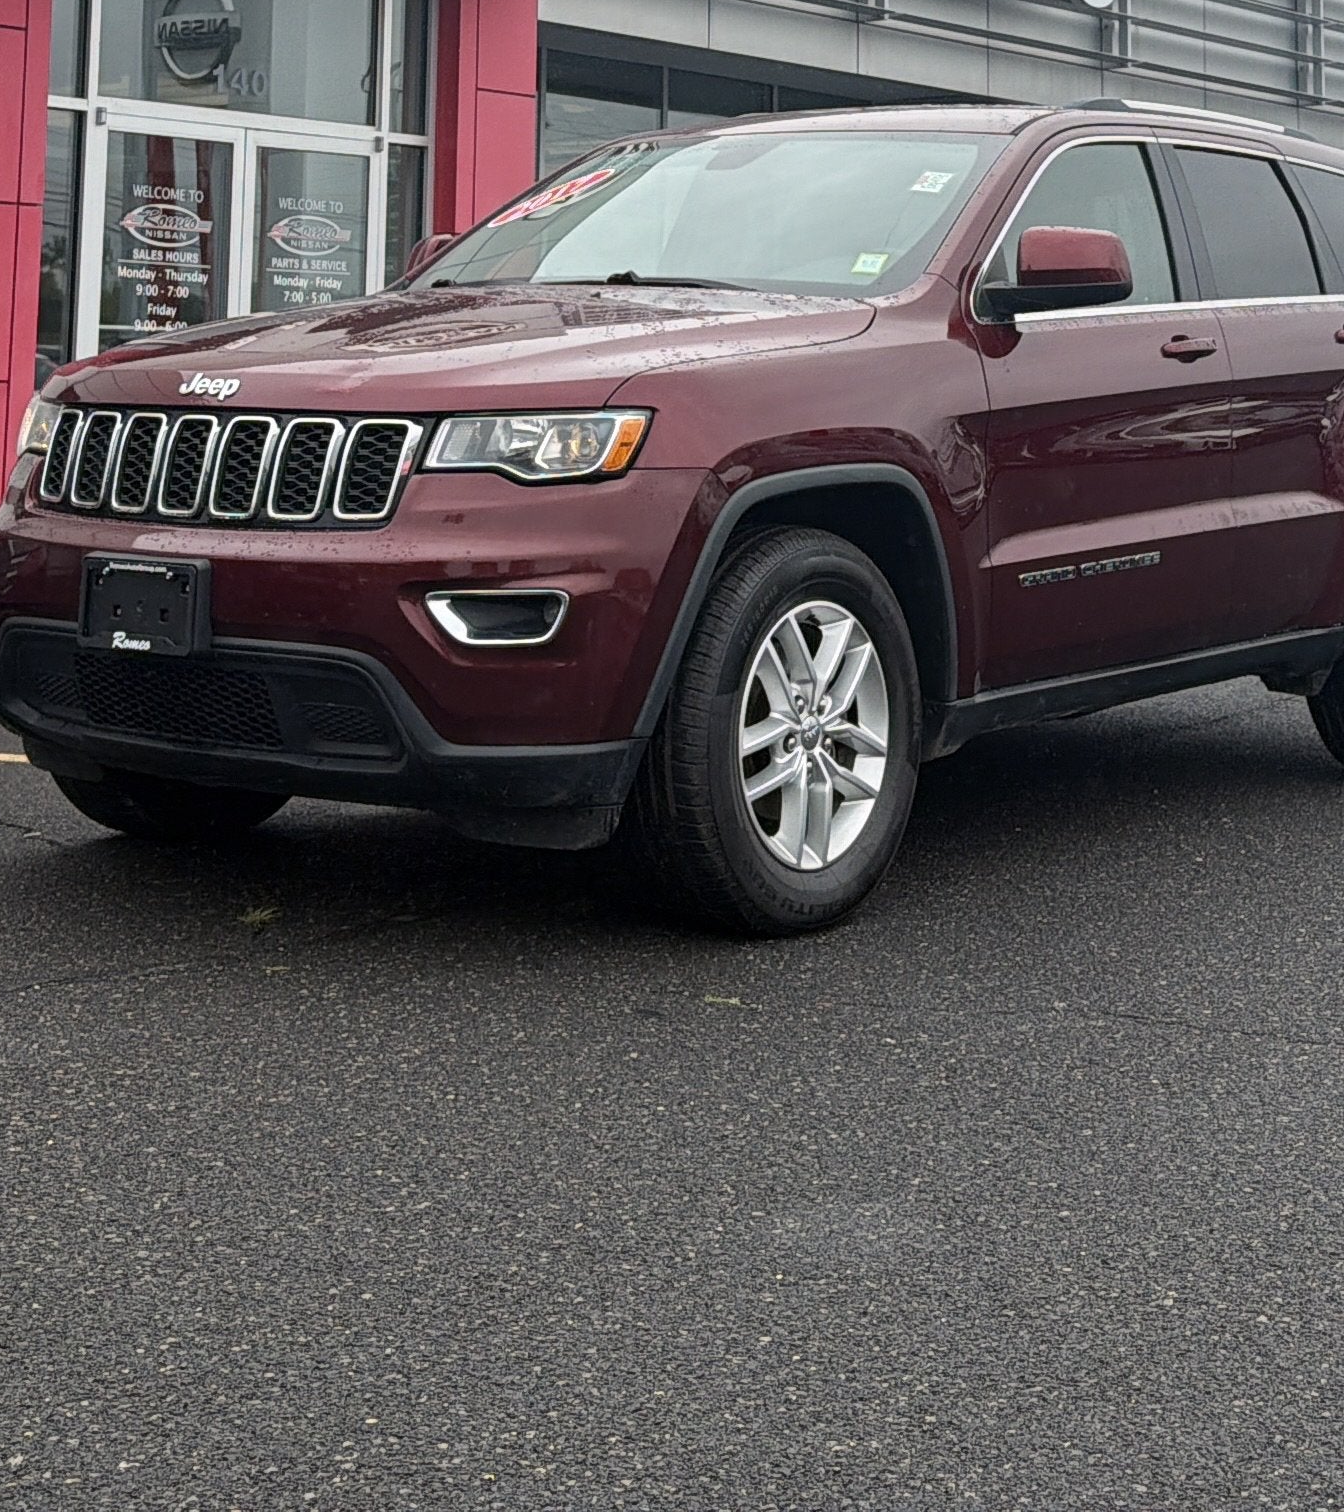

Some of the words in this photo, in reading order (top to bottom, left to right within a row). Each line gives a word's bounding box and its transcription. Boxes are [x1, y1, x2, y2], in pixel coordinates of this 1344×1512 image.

[212, 63, 268, 97] 140
[132, 184, 187, 201] WELCOME
[189, 189, 204, 203] TO
[278, 197, 327, 212] WELCOME
[329, 200, 344, 214] TO
[138, 207, 198, 229] Romeo
[145, 229, 187, 241] NISSAN
[285, 217, 338, 239] Romeo
[290, 239, 329, 249] NISSAN
[132, 248, 163, 262] SALES
[165, 251, 199, 263] HOURS
[271, 257, 300, 268] PARTS
[311, 259, 348, 272] SERVICE
[117, 266, 156, 282] Monday
[165, 269, 209, 285] Thursday
[273, 274, 309, 289] Monday
[315, 276, 343, 291] Friday
[135, 285, 159, 297] 9:00
[167, 286, 190, 298] 7:00
[283, 290, 304, 304] 7:00
[311, 291, 332, 305] 5:00
[147, 303, 177, 319] Friday
[178, 372, 240, 401] Jeep
[112, 631, 151, 651] Romeo
